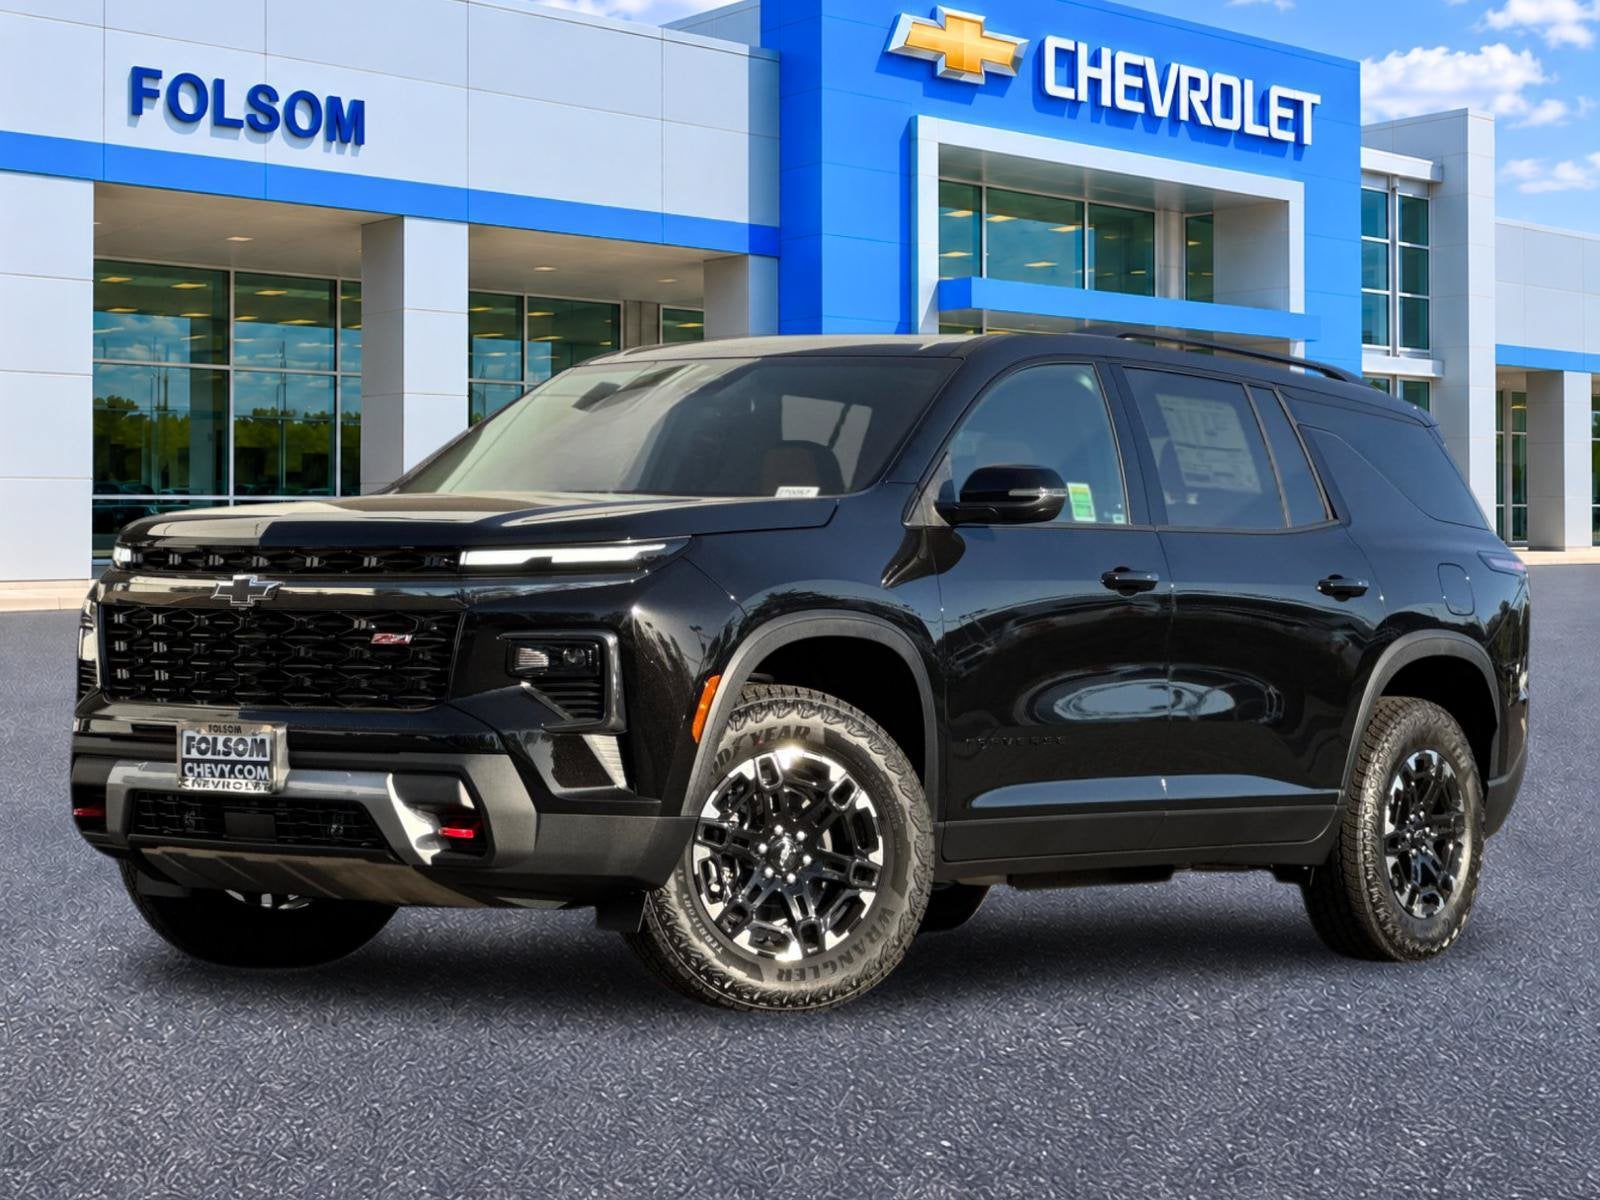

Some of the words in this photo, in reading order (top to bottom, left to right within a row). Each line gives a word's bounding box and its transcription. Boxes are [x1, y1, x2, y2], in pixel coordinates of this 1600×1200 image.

[1043, 35, 1321, 146] CHEVROLET
[130, 65, 365, 146] FOLSOM
[208, 724, 242, 734] FOLSOM
[185, 735, 268, 758] FOLSOM
[184, 762, 269, 781] CHEVY.COM
[178, 778, 274, 793] CHEVROLET
[776, 907, 896, 982] WRANGLER
